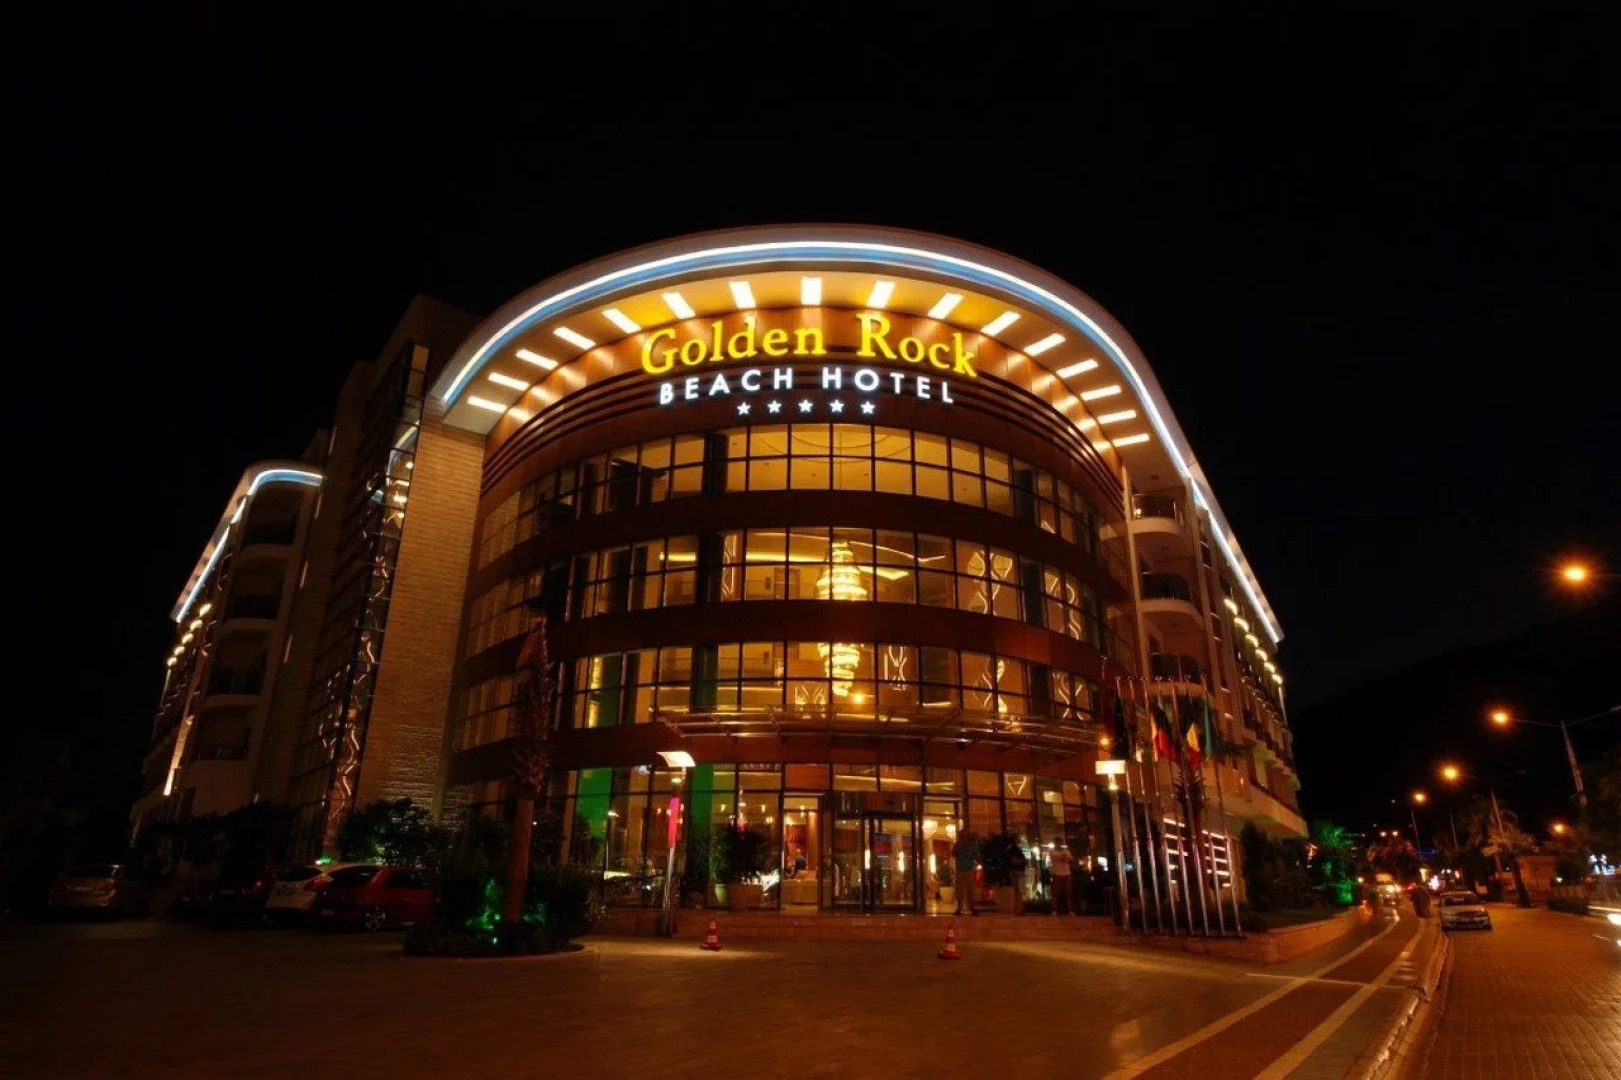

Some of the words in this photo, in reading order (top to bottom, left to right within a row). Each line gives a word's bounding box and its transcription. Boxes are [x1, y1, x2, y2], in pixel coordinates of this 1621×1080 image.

[641, 315, 827, 374] Golden
[856, 313, 977, 378] Rock
[659, 367, 793, 406] BEACH
[821, 366, 954, 404] HOTEL
